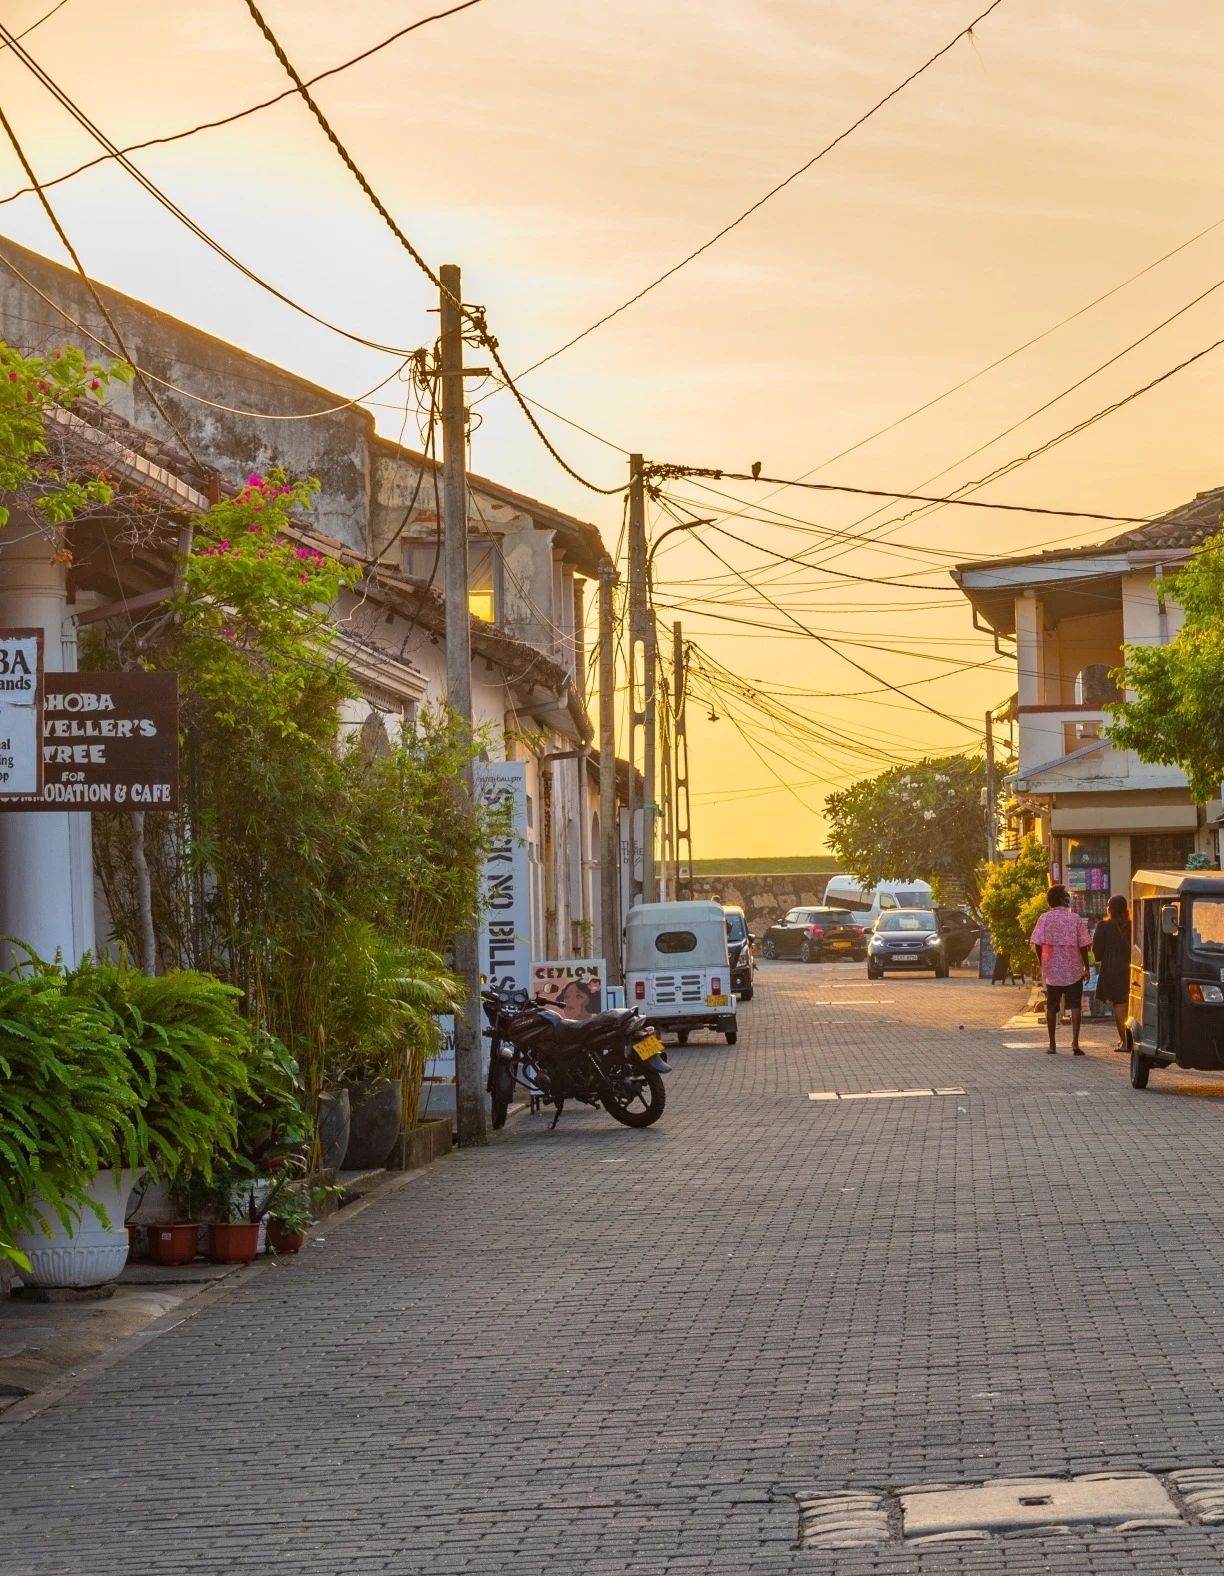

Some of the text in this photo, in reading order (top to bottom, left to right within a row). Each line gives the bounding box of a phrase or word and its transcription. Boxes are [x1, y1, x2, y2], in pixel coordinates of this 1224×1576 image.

[44, 693, 115, 712] HOBA
[44, 744, 106, 764] TREE
[61, 771, 85, 781] FOR
[0, 783, 170, 802] ODATION & CAFE
[488, 875, 514, 909] NO
[489, 921, 515, 991] BILLS
[536, 966, 598, 979] CEYLON
